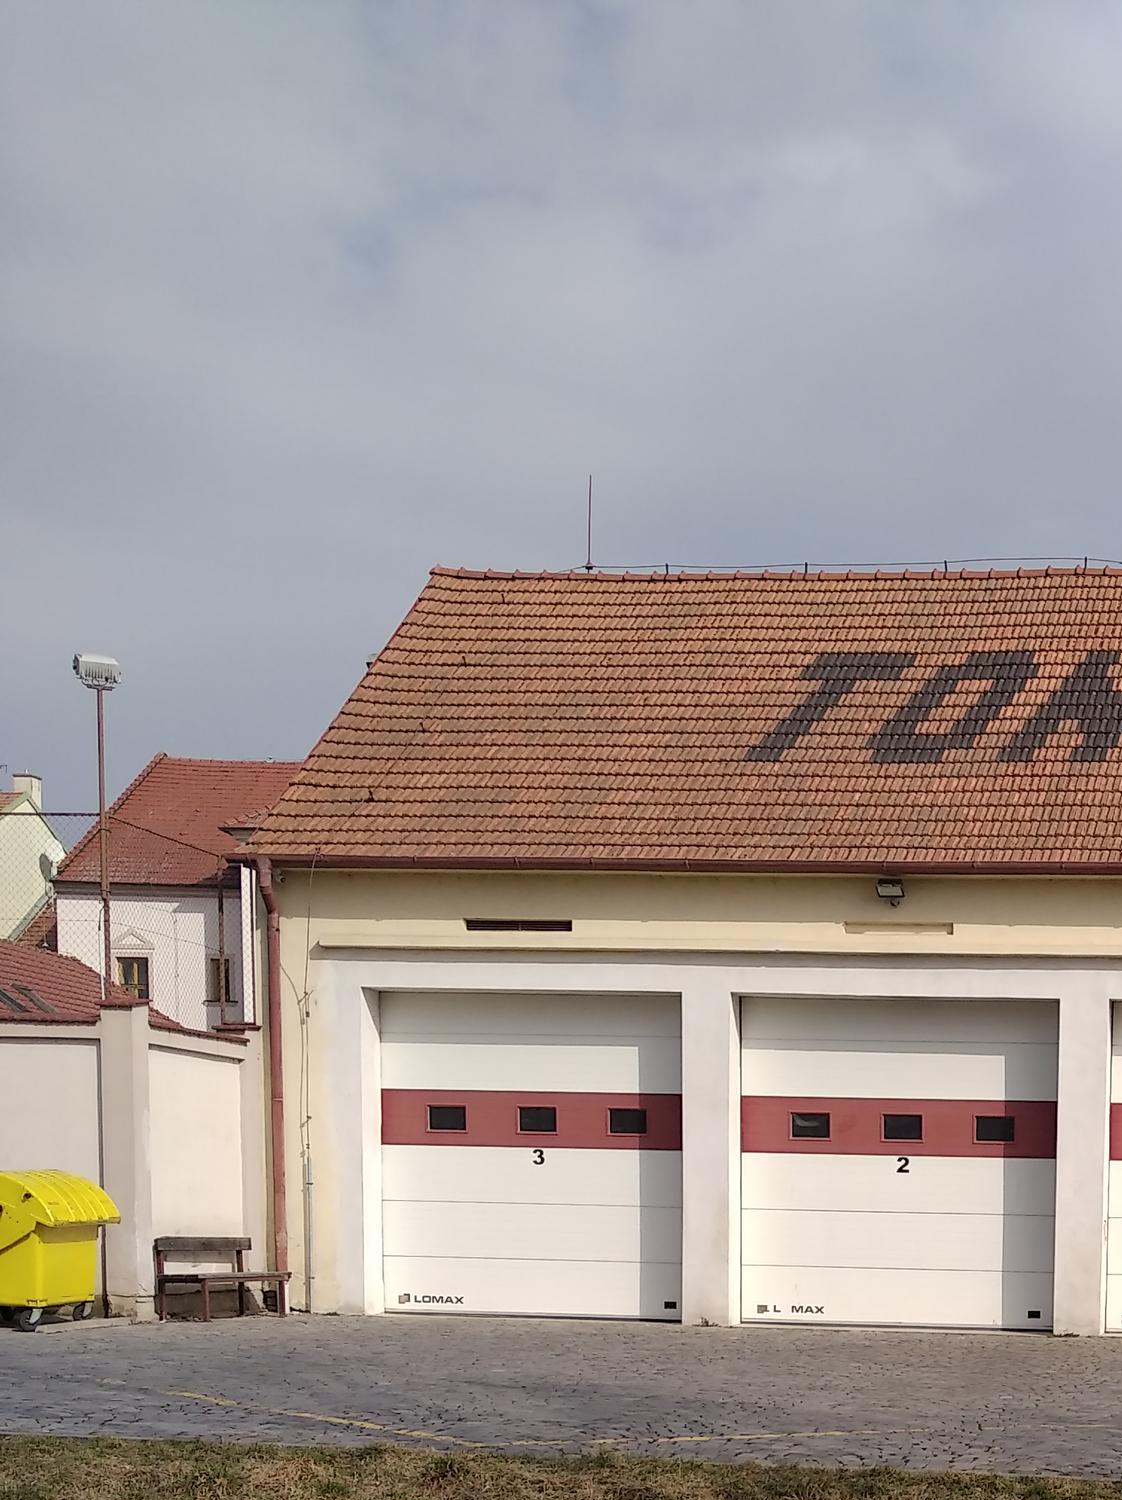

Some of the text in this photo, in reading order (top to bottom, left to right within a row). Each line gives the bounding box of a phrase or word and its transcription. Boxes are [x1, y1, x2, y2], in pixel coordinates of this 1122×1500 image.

[532, 1149, 546, 1165] 3
[896, 1157, 910, 1174] 2
[414, 1295, 464, 1304] LOMAX
[773, 1305, 824, 1314] LMAX
